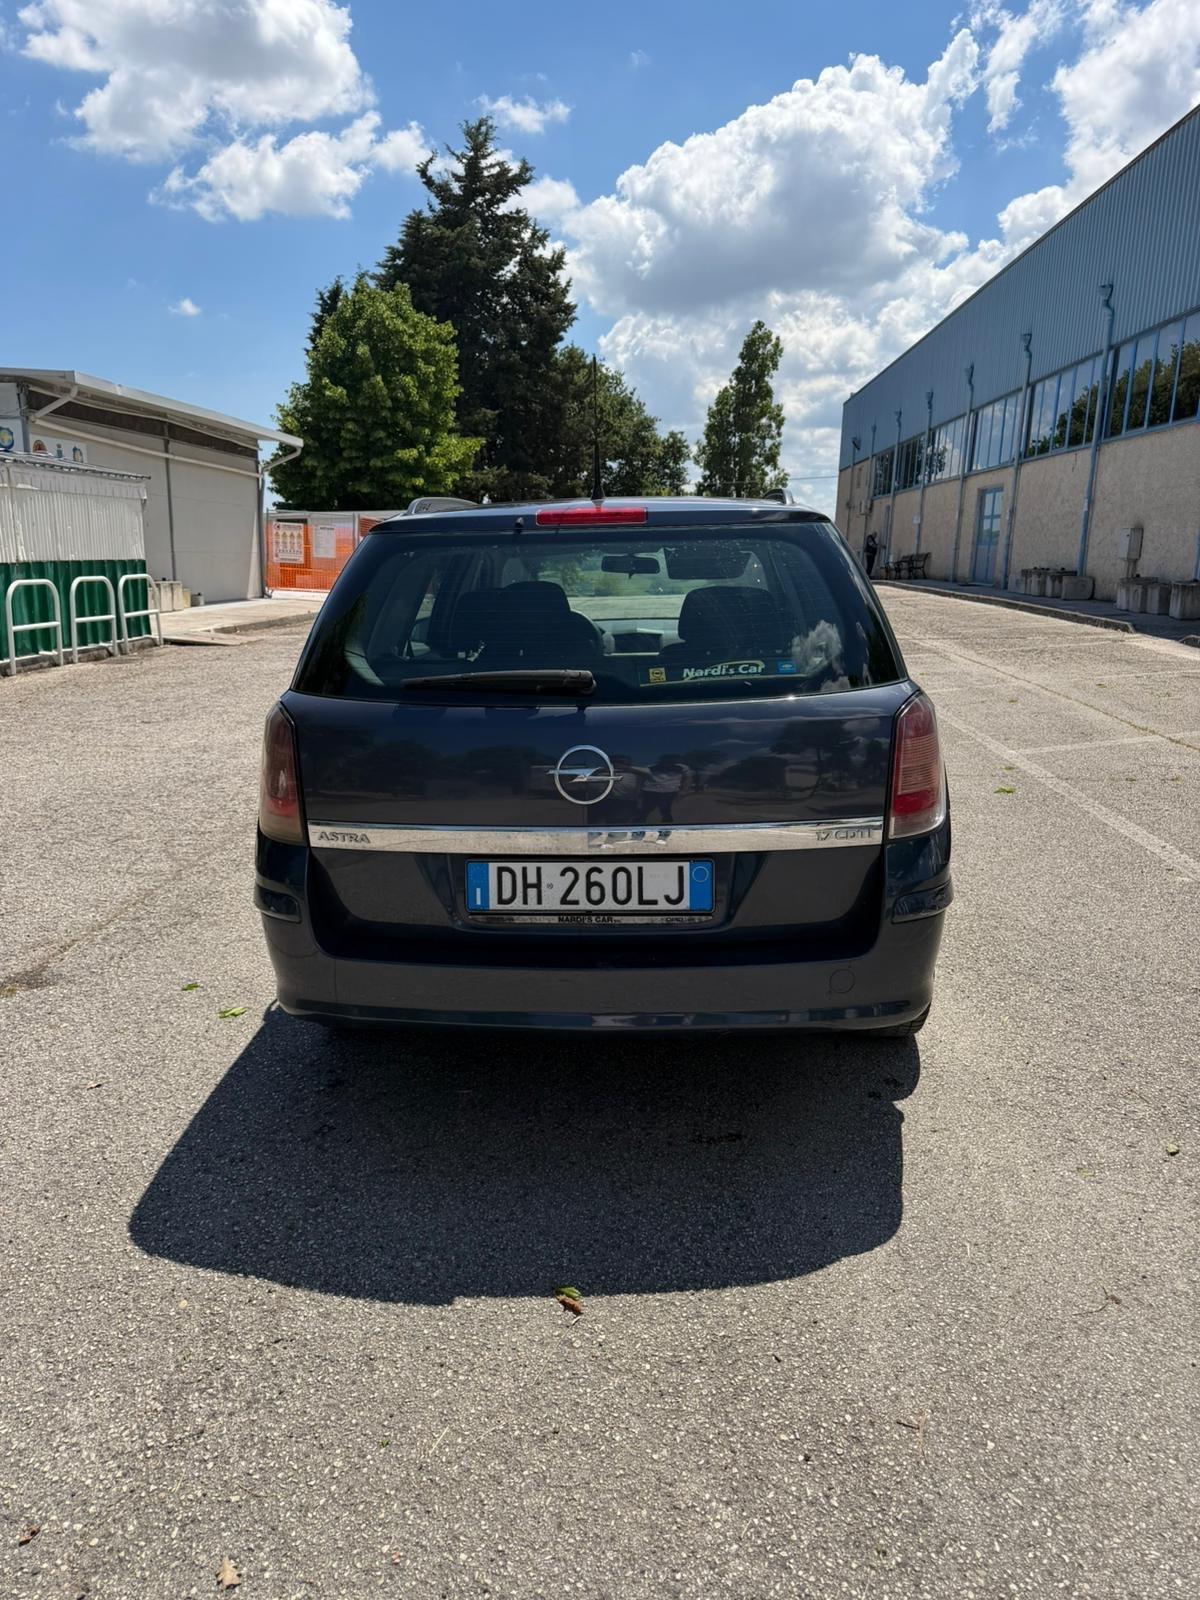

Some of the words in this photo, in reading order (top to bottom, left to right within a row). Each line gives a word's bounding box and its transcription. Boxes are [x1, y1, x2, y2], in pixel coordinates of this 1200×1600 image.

[682, 664, 735, 678] Nardi's
[738, 663, 765, 674] Car
[318, 831, 371, 844] ASTRA
[496, 866, 543, 906] DH
[559, 866, 685, 906] 260LJ
[475, 887, 482, 905] I
